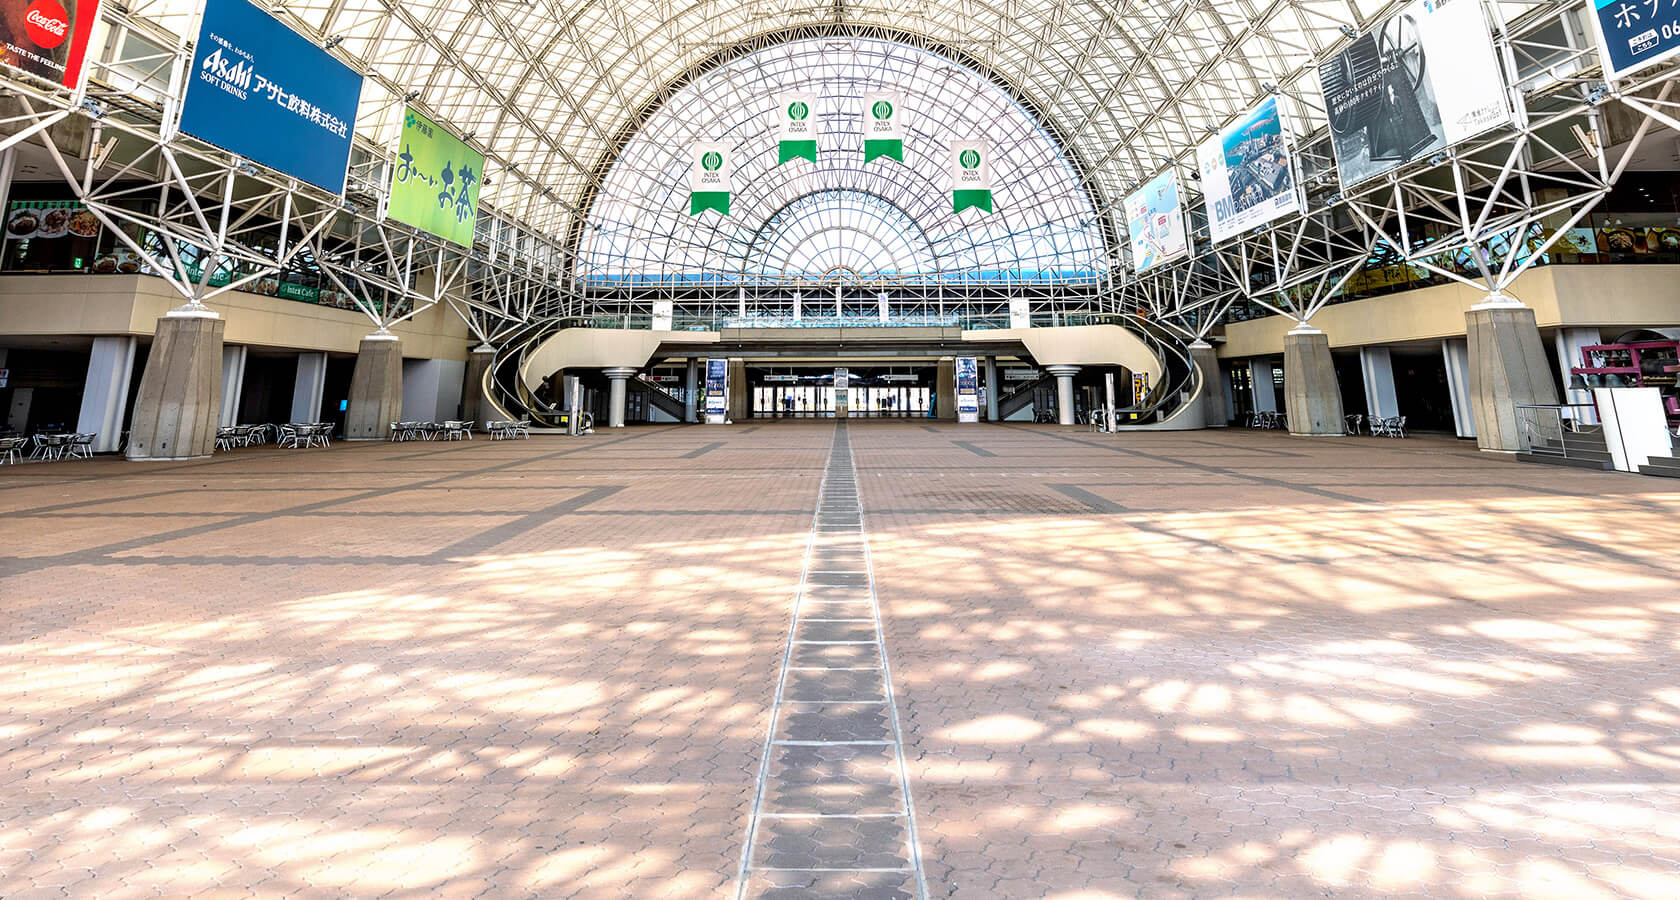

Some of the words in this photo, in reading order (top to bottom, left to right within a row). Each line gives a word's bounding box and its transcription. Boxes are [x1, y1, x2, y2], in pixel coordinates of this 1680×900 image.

[6, 43, 26, 56] TASTE
[27, 51, 40, 62] THE
[40, 57, 66, 73] FEELING
[203, 48, 253, 90] Asahi
[200, 70, 220, 87] SOFT
[220, 80, 248, 101] DRINKS
[252, 73, 348, 139] アサヒ飲料株式会社
[287, 285, 300, 295] Intex
[301, 288, 315, 298] Cafe
